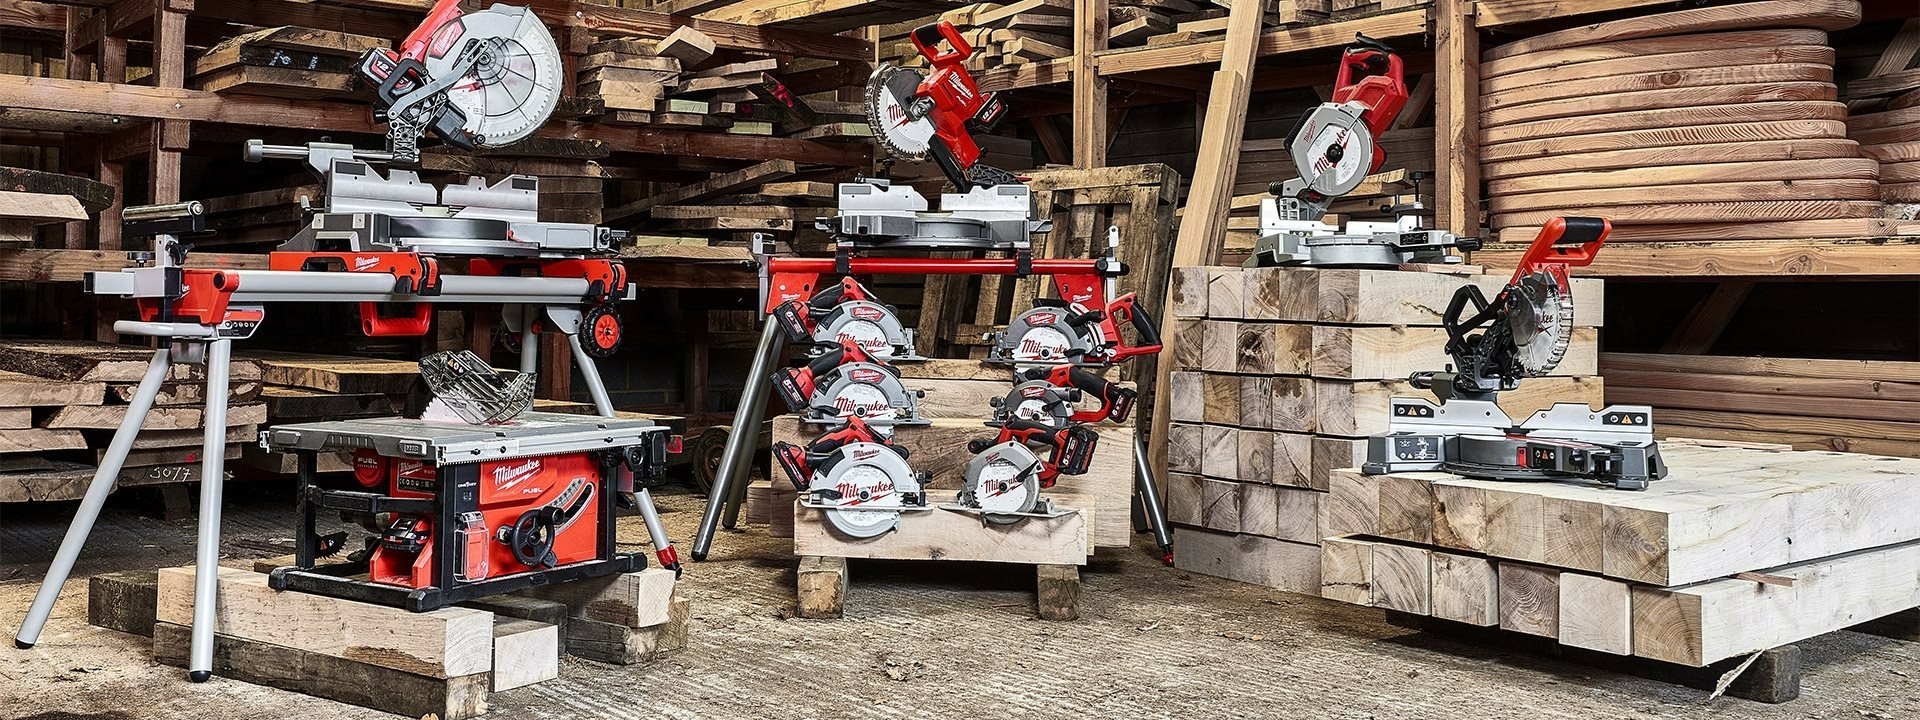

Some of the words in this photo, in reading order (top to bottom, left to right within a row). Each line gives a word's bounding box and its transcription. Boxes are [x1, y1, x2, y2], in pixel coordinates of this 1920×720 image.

[949, 70, 974, 98] Milwaukee
[834, 396, 889, 412] Milukee
[493, 459, 541, 486] Milwaukee
[835, 480, 895, 499] Milukee
